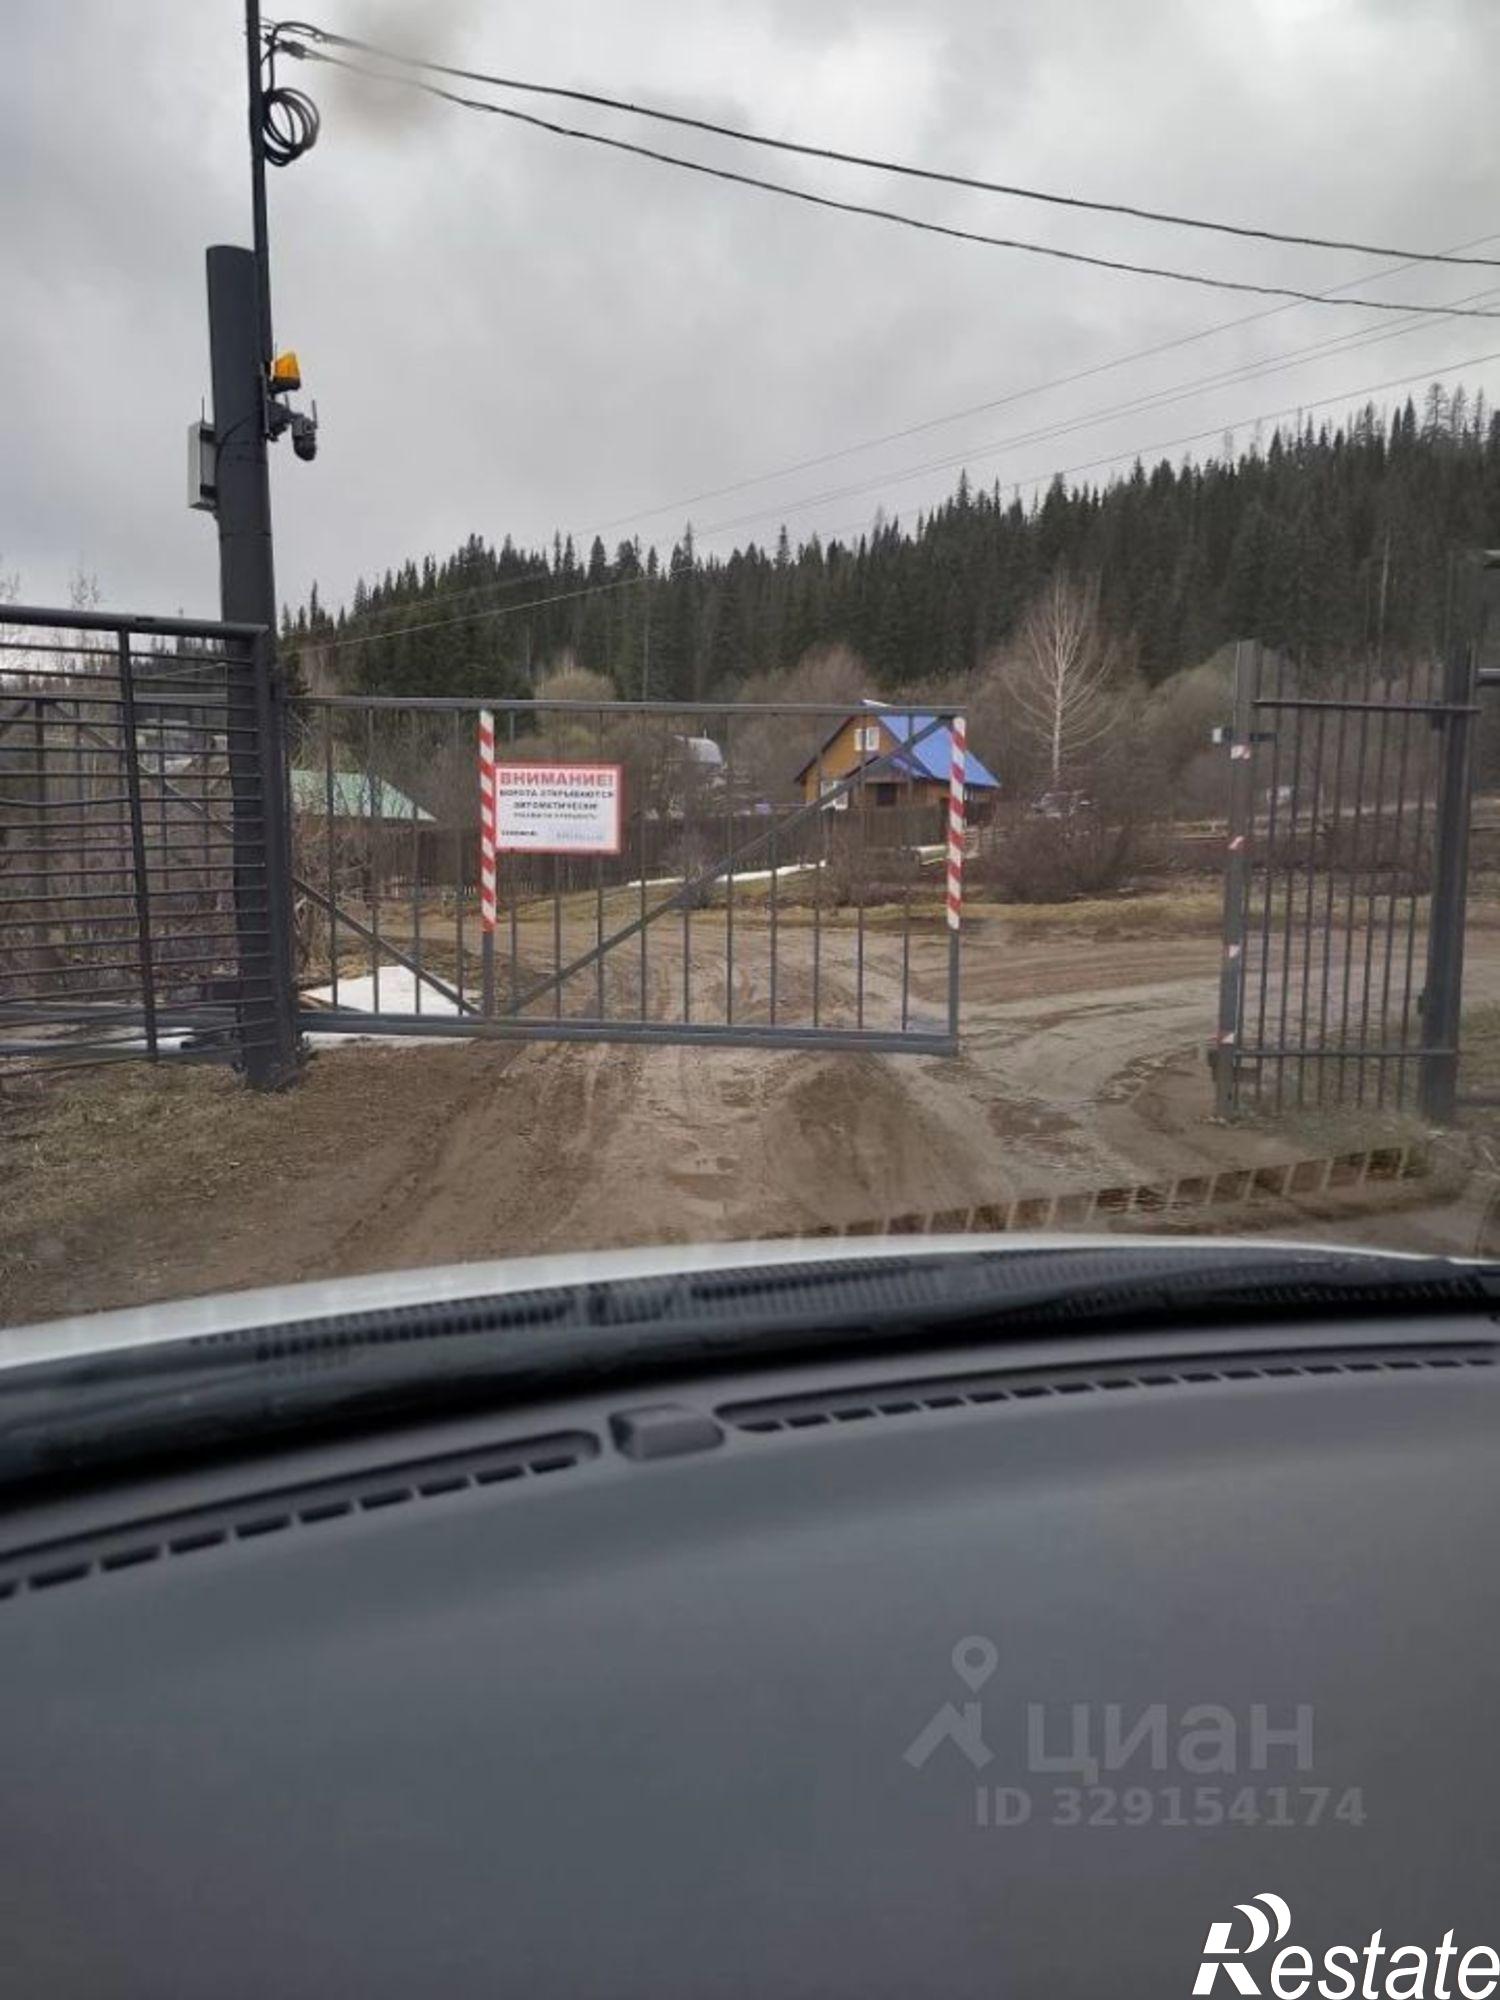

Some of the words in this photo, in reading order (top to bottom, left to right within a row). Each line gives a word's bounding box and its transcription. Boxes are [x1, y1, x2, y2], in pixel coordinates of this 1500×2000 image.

[500, 772, 613, 787] ВНИМАНИЕ!
[500, 789, 538, 797] ВОРОТА
[540, 789, 614, 799] ОТКРЫВАЮТСЯ
